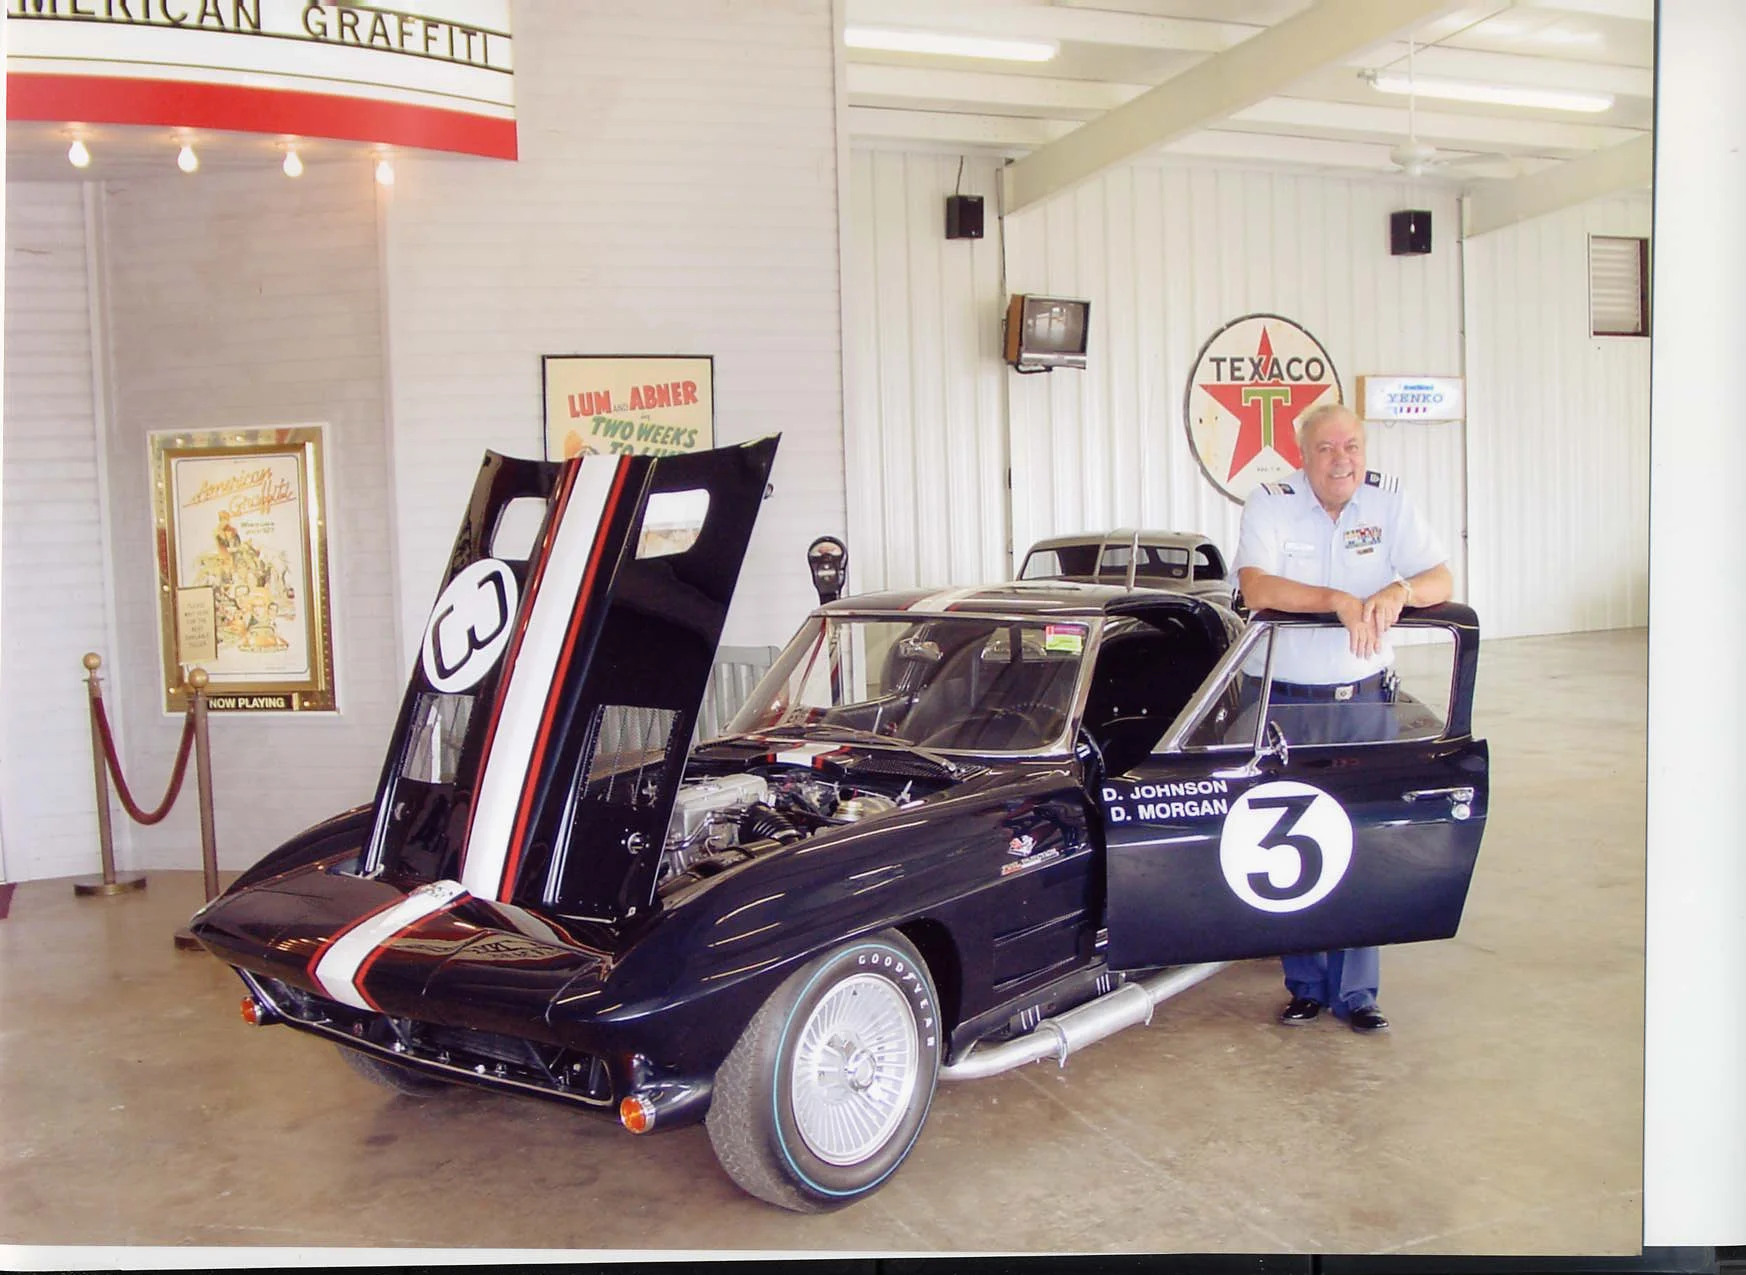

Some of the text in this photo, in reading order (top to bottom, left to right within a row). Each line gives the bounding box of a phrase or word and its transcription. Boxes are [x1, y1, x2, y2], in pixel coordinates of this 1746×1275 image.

[301, 6, 488, 65] GRAFFITI
[1209, 357, 1325, 382] TEXACO
[568, 389, 612, 418] LUM
[629, 380, 699, 411] ABNER
[1387, 392, 1444, 404] YENKO
[591, 416, 699, 449] TWO WEEKS
[1242, 387, 1291, 449] T
[208, 697, 285, 709] NOW PLAYING
[1102, 780, 1228, 802] D. JOHNSON
[1110, 799, 1228, 822] D. MORGAN
[1246, 794, 1323, 901] 3
[858, 952, 936, 1047] GOODYEAR
